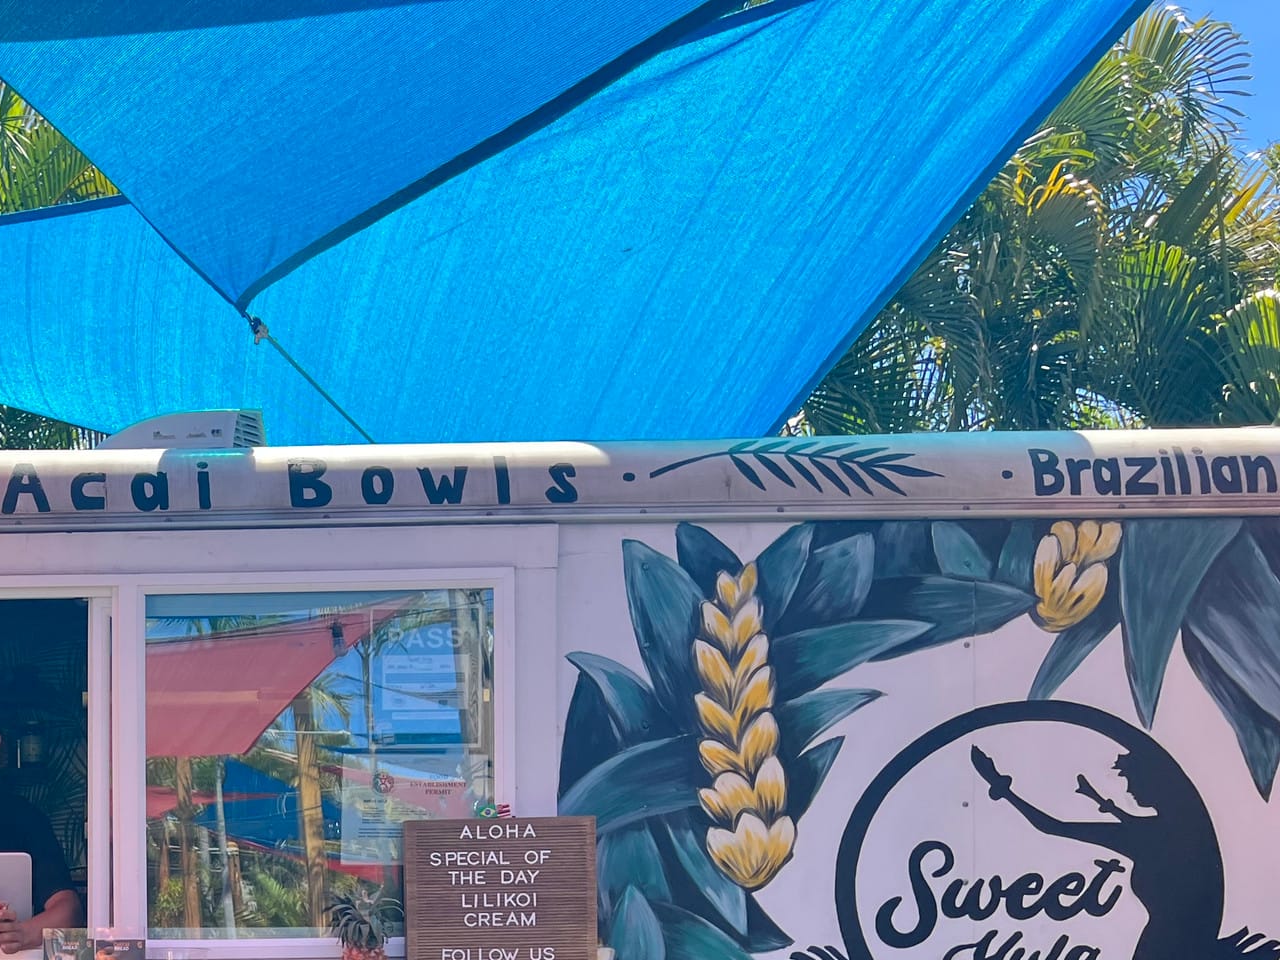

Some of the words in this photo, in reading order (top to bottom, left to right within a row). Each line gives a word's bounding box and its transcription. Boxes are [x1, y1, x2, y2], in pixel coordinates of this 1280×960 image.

[1027, 446, 1278, 496] Brazilian
[1, 462, 213, 514] Acai
[287, 455, 578, 508] Bowls
[386, 628, 464, 648] PASS
[460, 824, 536, 840] ALOHA
[430, 850, 510, 866] SPECIAL
[524, 850, 551, 864] OF
[448, 870, 486, 885] THE
[500, 870, 540, 885] DAY
[462, 893, 537, 908] LILIKOI
[875, 841, 1125, 949] Sweet
[464, 912, 536, 927] CREAM
[530, 948, 555, 960] US
